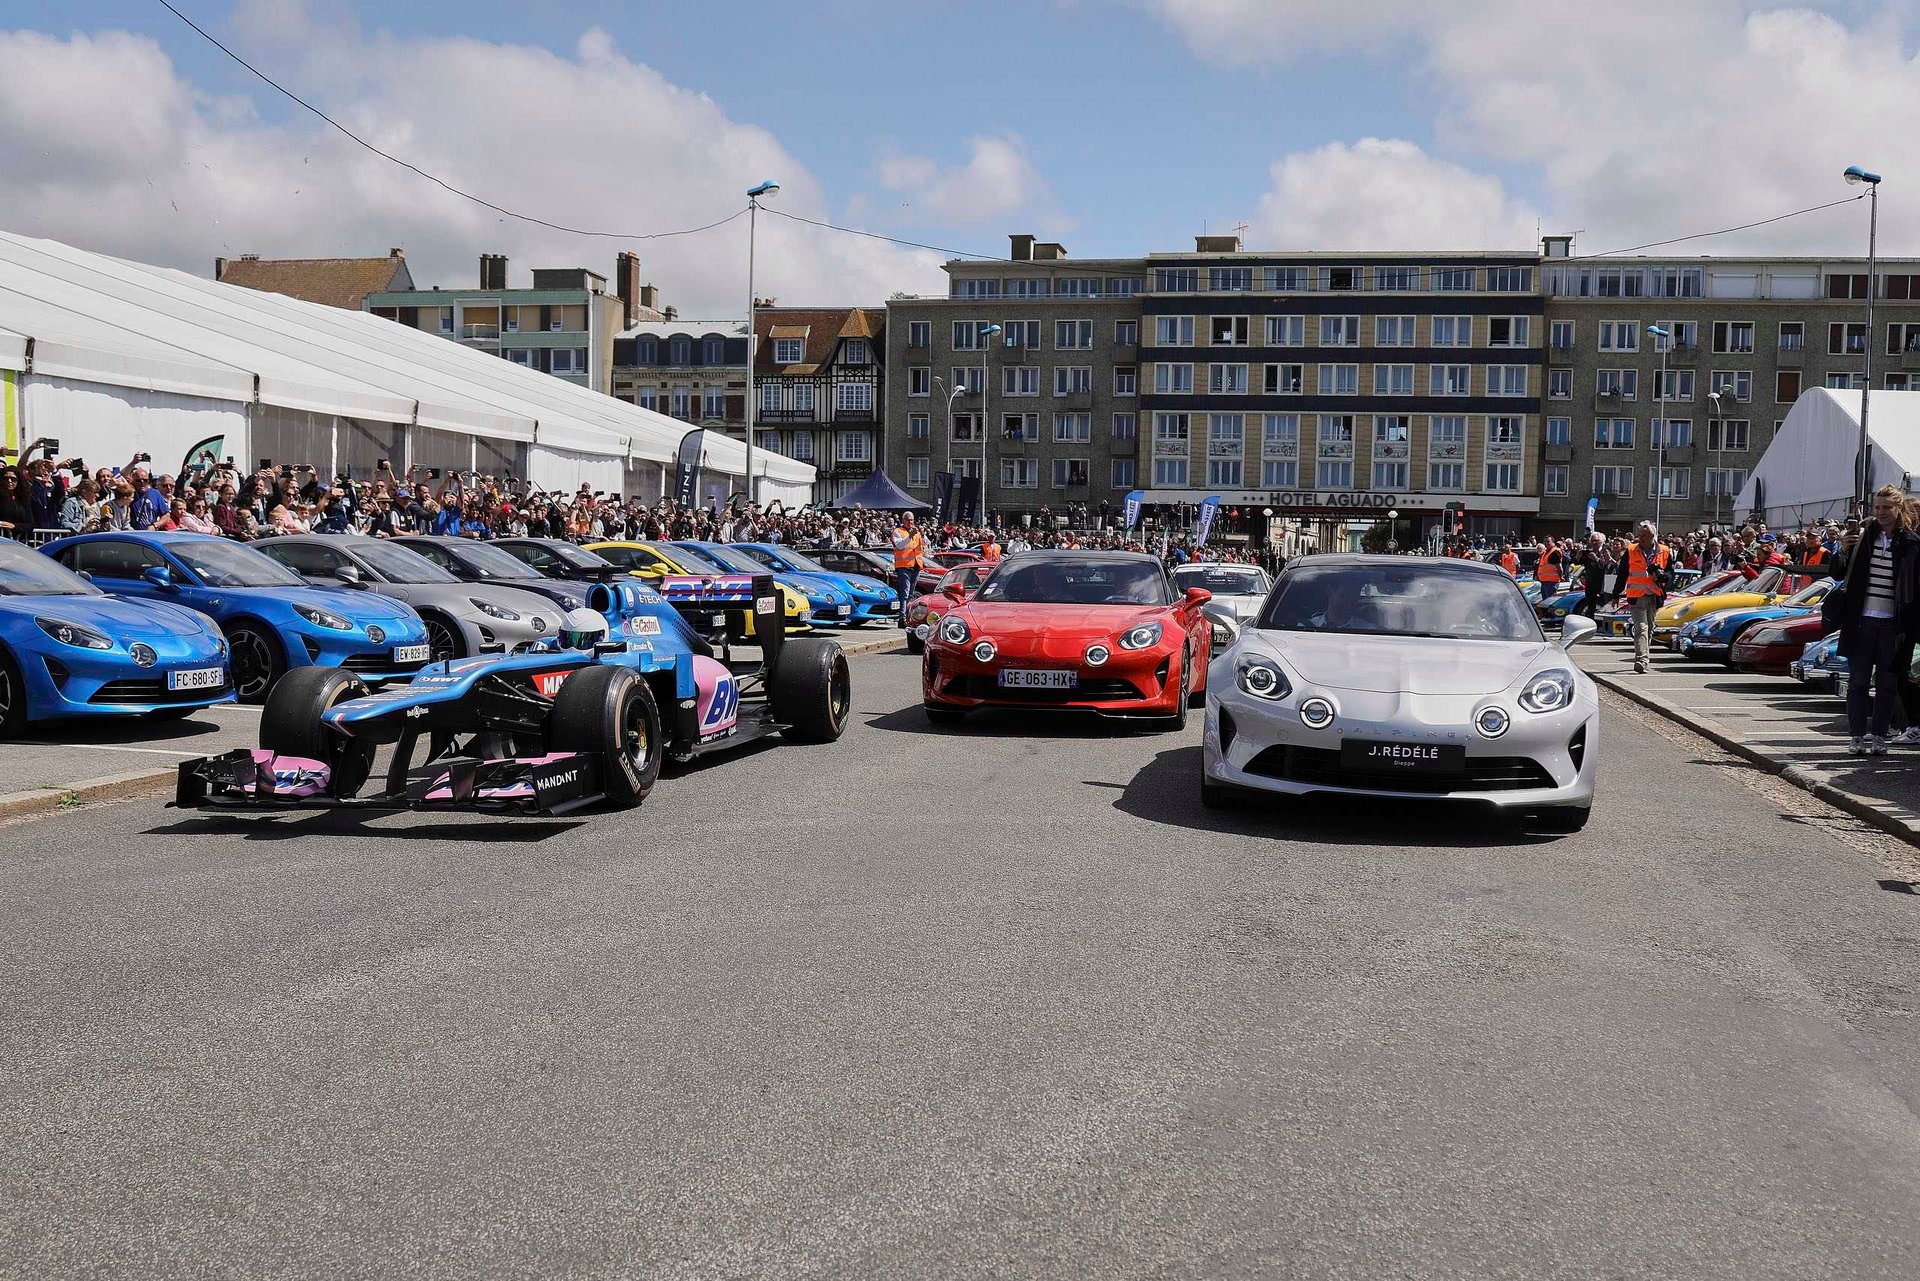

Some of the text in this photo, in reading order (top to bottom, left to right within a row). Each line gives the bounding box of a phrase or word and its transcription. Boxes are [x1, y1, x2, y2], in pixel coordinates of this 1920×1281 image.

[681, 463, 692, 505] PINE
[1269, 492, 1397, 508] HOTEL AGUADO
[639, 618, 660, 632] Castrol
[176, 670, 219, 687] FC-680-SF
[1006, 671, 1069, 687] GE-063-HX
[1368, 744, 1439, 759] J.RÉDÉLÉ
